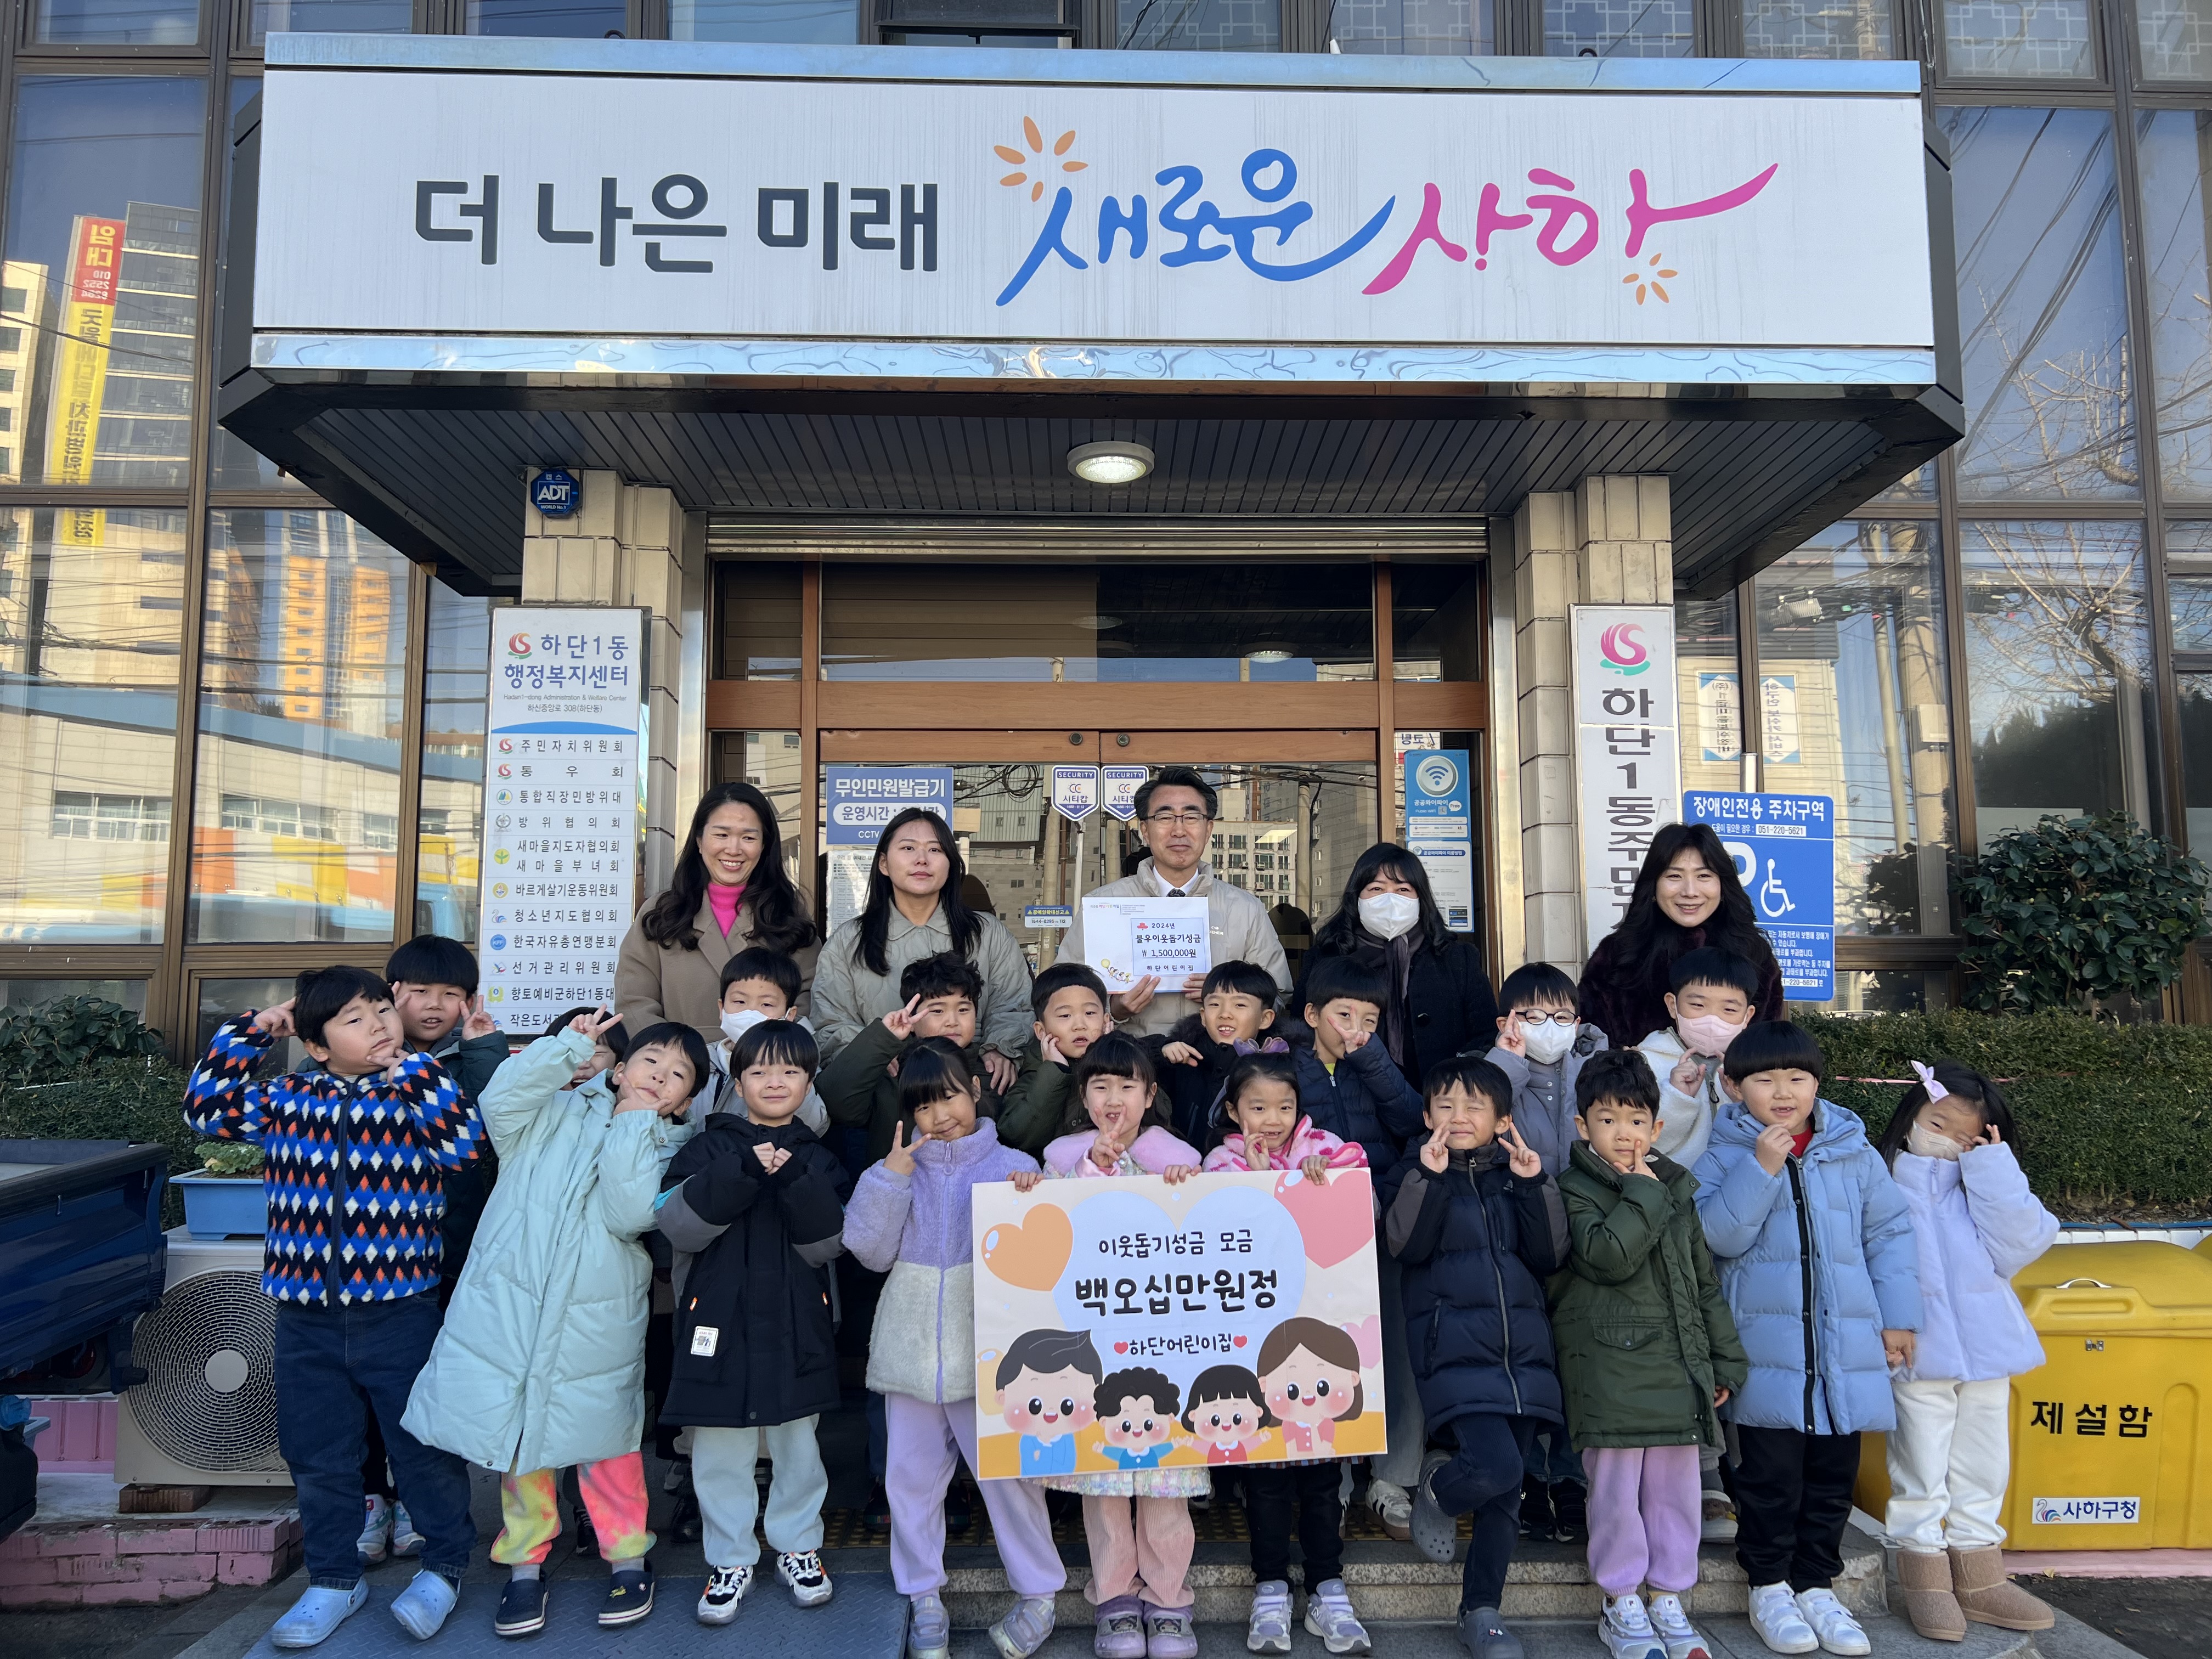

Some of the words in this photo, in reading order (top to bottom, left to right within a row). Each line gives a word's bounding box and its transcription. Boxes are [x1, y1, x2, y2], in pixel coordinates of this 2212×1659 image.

[415, 175, 499, 265] 더
[537, 174, 727, 273] 나은
[758, 182, 938, 272] 미래
[995, 148, 1396, 307] 새로운
[1361, 163, 1779, 295] 사하
[538, 485, 570, 500] ADT
[541, 634, 629, 661] 하단1동
[504, 664, 628, 689] 행정복지센터
[564, 704, 603, 713] 308(하단동)
[835, 778, 945, 797] 무인민원발급기
[520, 791, 621, 804] 통합직장민방위대
[842, 806, 890, 821] 운영시간
[1694, 797, 1763, 820] 장애인전용
[1769, 800, 1824, 821] 주차구역
[1726, 823, 1740, 833] 필요한
[1741, 824, 1751, 833] 경우
[1758, 826, 1803, 835] 051-220-5621
[517, 840, 620, 854] 새마을지도자협의회
[516, 883, 618, 897] 바르게살기운동위원회
[515, 909, 617, 923] 청소년지도협의회
[514, 935, 616, 949] 한국자유총연맹분회
[1136, 934, 1201, 944] 불우이웃돕기성금
[1152, 949, 1197, 958] 1,500,000원
[511, 988, 614, 1001] 향토예비군하단1동대
[510, 1013, 561, 1027] 작은도서
[1099, 1231, 1205, 1259] 이웃돕기성금
[1220, 1229, 1254, 1254] 모금
[1075, 1268, 1278, 1317] 백오십만원정
[1129, 1333, 1232, 1356] 하단어린이집
[2031, 1401, 2153, 1438] 제설함
[2063, 1501, 2136, 1520] 사하구청
